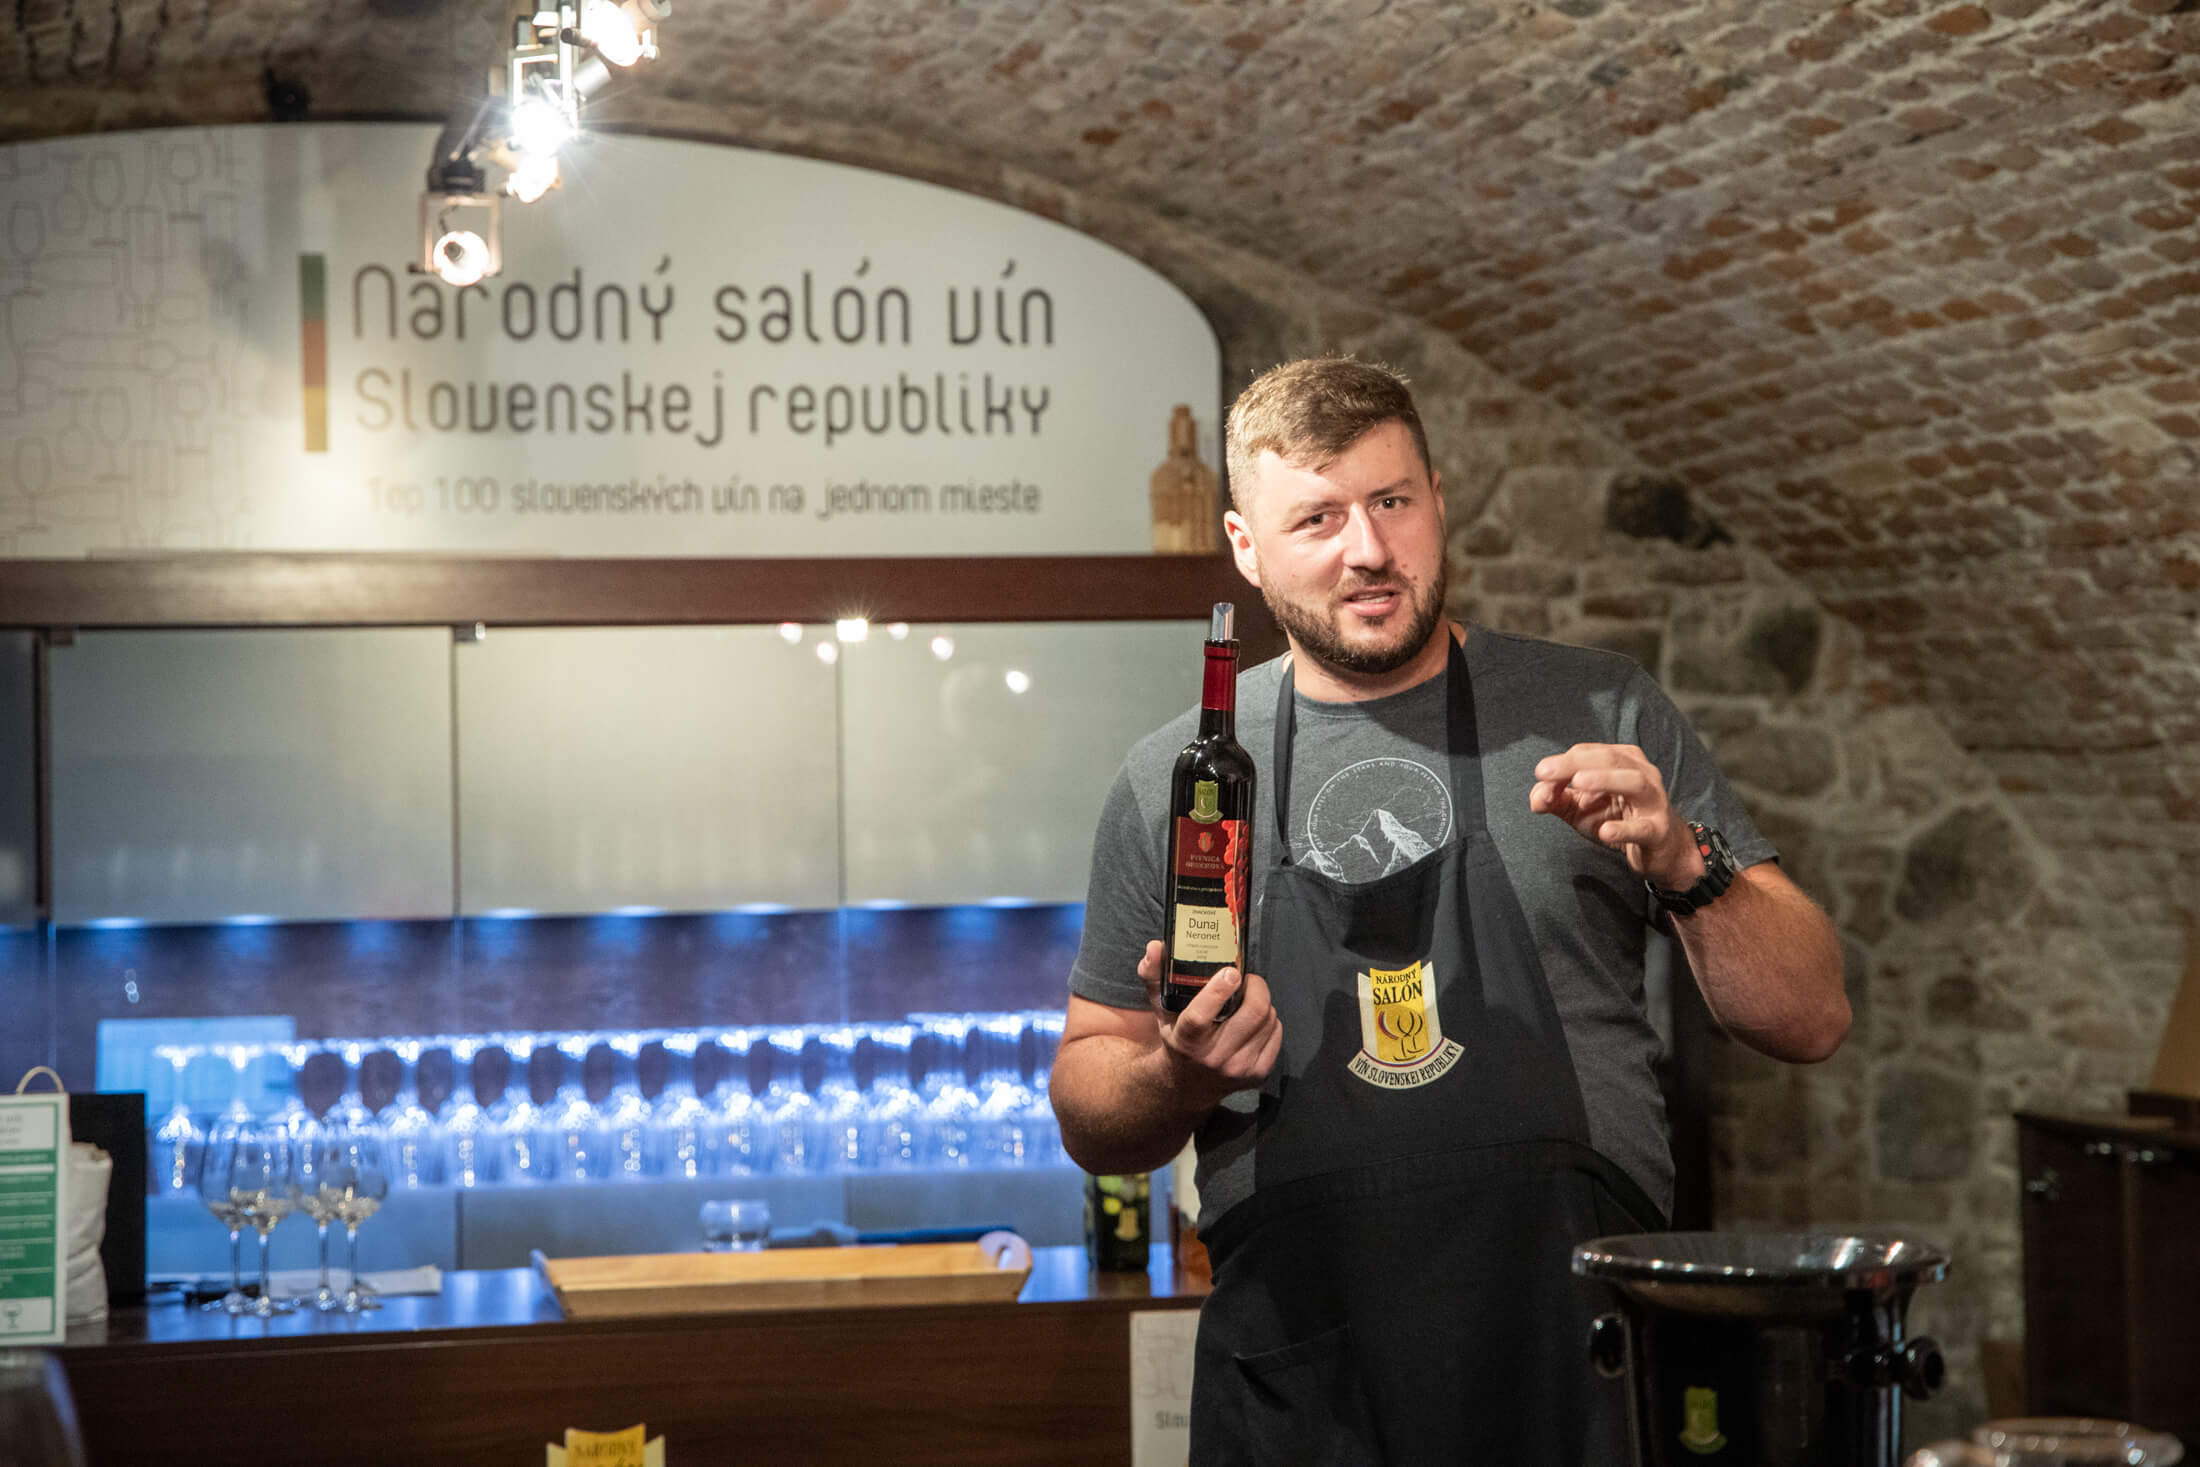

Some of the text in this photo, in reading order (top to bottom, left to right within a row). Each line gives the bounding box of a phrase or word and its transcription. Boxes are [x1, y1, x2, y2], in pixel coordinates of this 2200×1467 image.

[714, 256, 911, 345] salón
[948, 258, 1054, 346] vín
[354, 366, 1051, 448] Slovenskej republiky
[432, 476, 499, 514] 100
[510, 471, 705, 515] slovenských
[711, 472, 762, 515] vín
[768, 484, 806, 514] na
[814, 477, 933, 521] jednom
[938, 476, 1043, 515] mieste
[1186, 930, 1220, 941] Neronet
[1188, 917, 1220, 932] Dunaj
[1372, 979, 1423, 1006] SALÓN
[1354, 1043, 1459, 1087] VÍN SLOVENSKEJ REPUBLIKY
